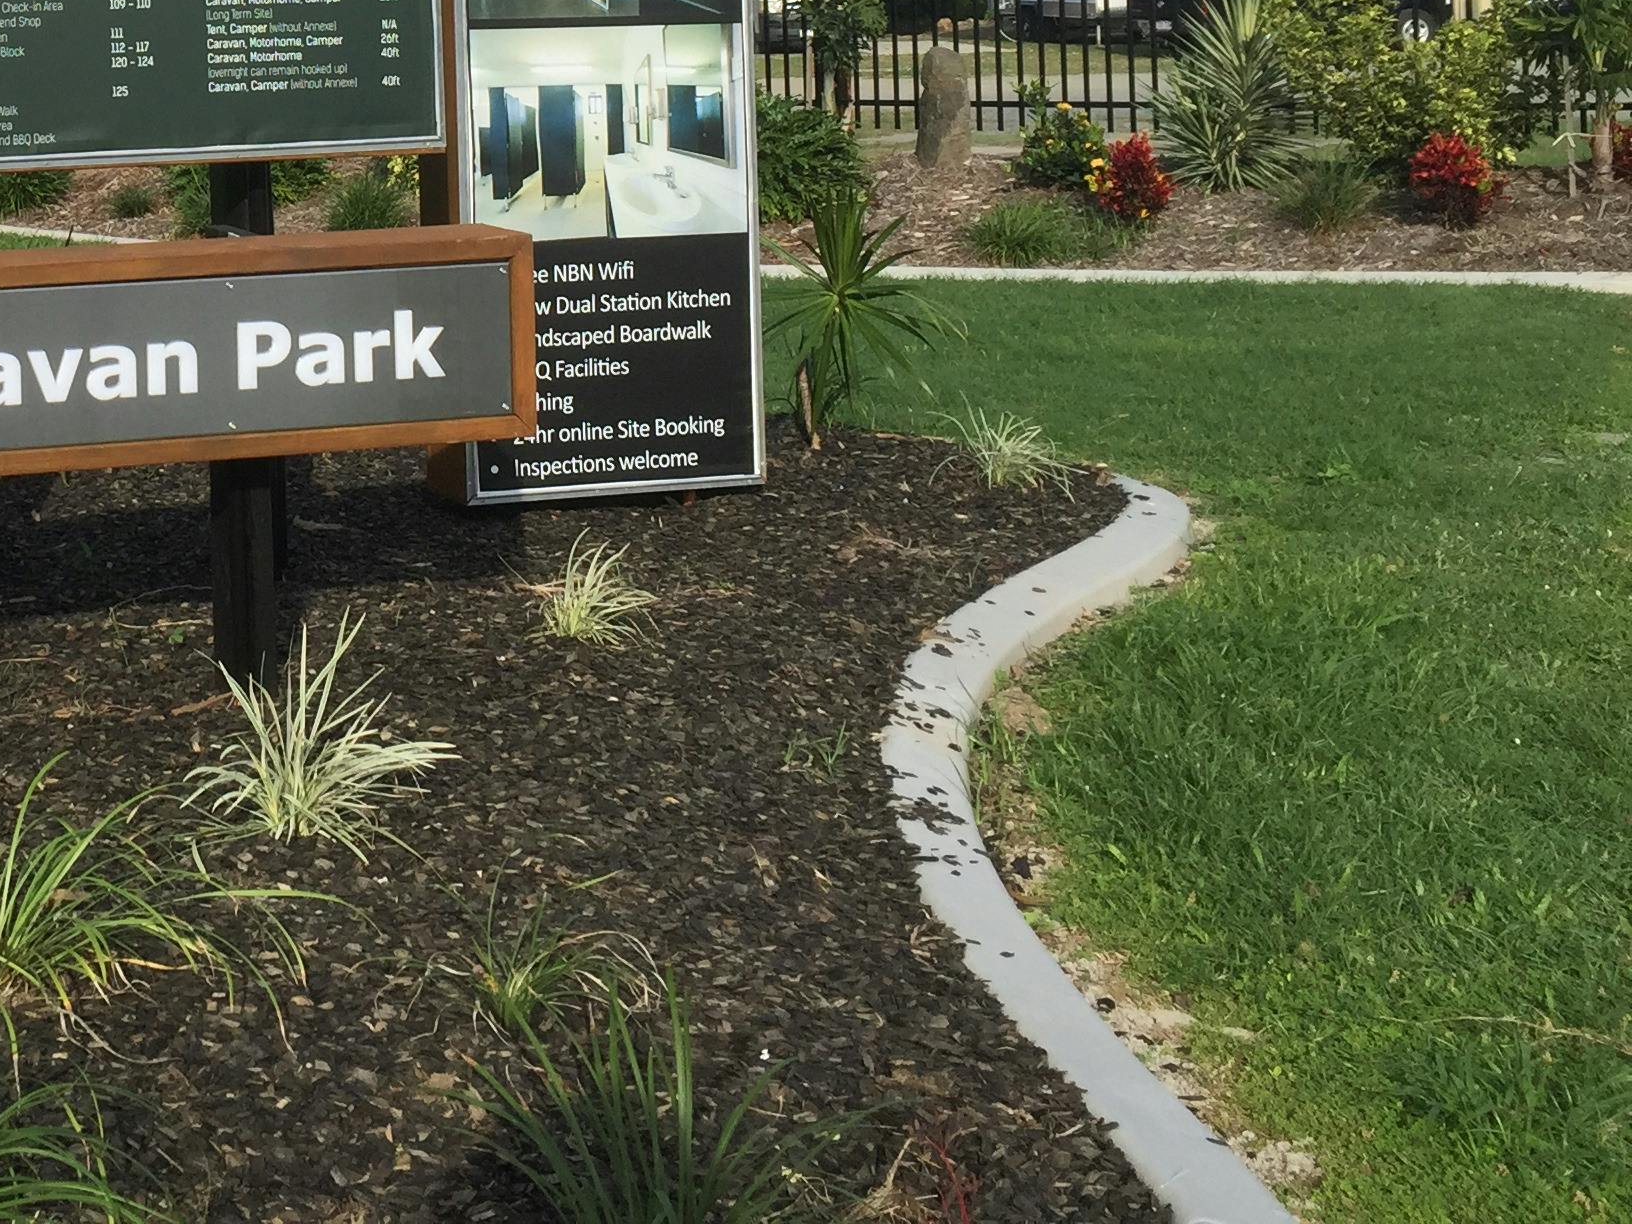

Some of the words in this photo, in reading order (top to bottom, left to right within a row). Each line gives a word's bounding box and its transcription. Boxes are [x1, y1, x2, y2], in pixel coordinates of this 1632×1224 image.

[2, 1, 42, 13] Check-in
[43, 1, 63, 11] Area
[231, 9, 252, 19] Term
[19, 16, 41, 28] Shop
[382, 19, 397, 29] N/A
[111, 28, 123, 38] 111
[230, 23, 267, 35] Camper
[306, 35, 343, 47] Camper
[381, 33, 399, 43] 26ft
[0, 46, 24, 57] Block
[111, 42, 125, 53] 112
[136, 41, 149, 52] 117
[381, 47, 399, 57] 40ft
[112, 57, 127, 67] 120
[138, 56, 154, 66] 124
[250, 51, 302, 62] Motorhome
[251, 67, 267, 76] can
[269, 65, 299, 75] remain
[301, 63, 333, 74] hooked
[251, 80, 288, 92] Camper
[382, 76, 400, 86] 40ft
[113, 86, 128, 97] 125
[13, 134, 31, 146] BBQ
[34, 133, 56, 144] Deck
[554, 264, 593, 282] NBN
[598, 261, 633, 280] Wifi
[557, 294, 595, 314] Dual
[600, 293, 661, 312] Station
[668, 289, 730, 308] Kitchen
[535, 325, 615, 349] ndscaped
[620, 320, 711, 343] Boardwalk
[237, 310, 445, 390] Park
[556, 357, 629, 378] Facilities
[536, 392, 574, 414] hing
[559, 422, 613, 442] online
[618, 420, 650, 438] Site
[655, 416, 725, 436] Booking
[515, 455, 615, 480] Inspections
[619, 450, 698, 470] welcome
